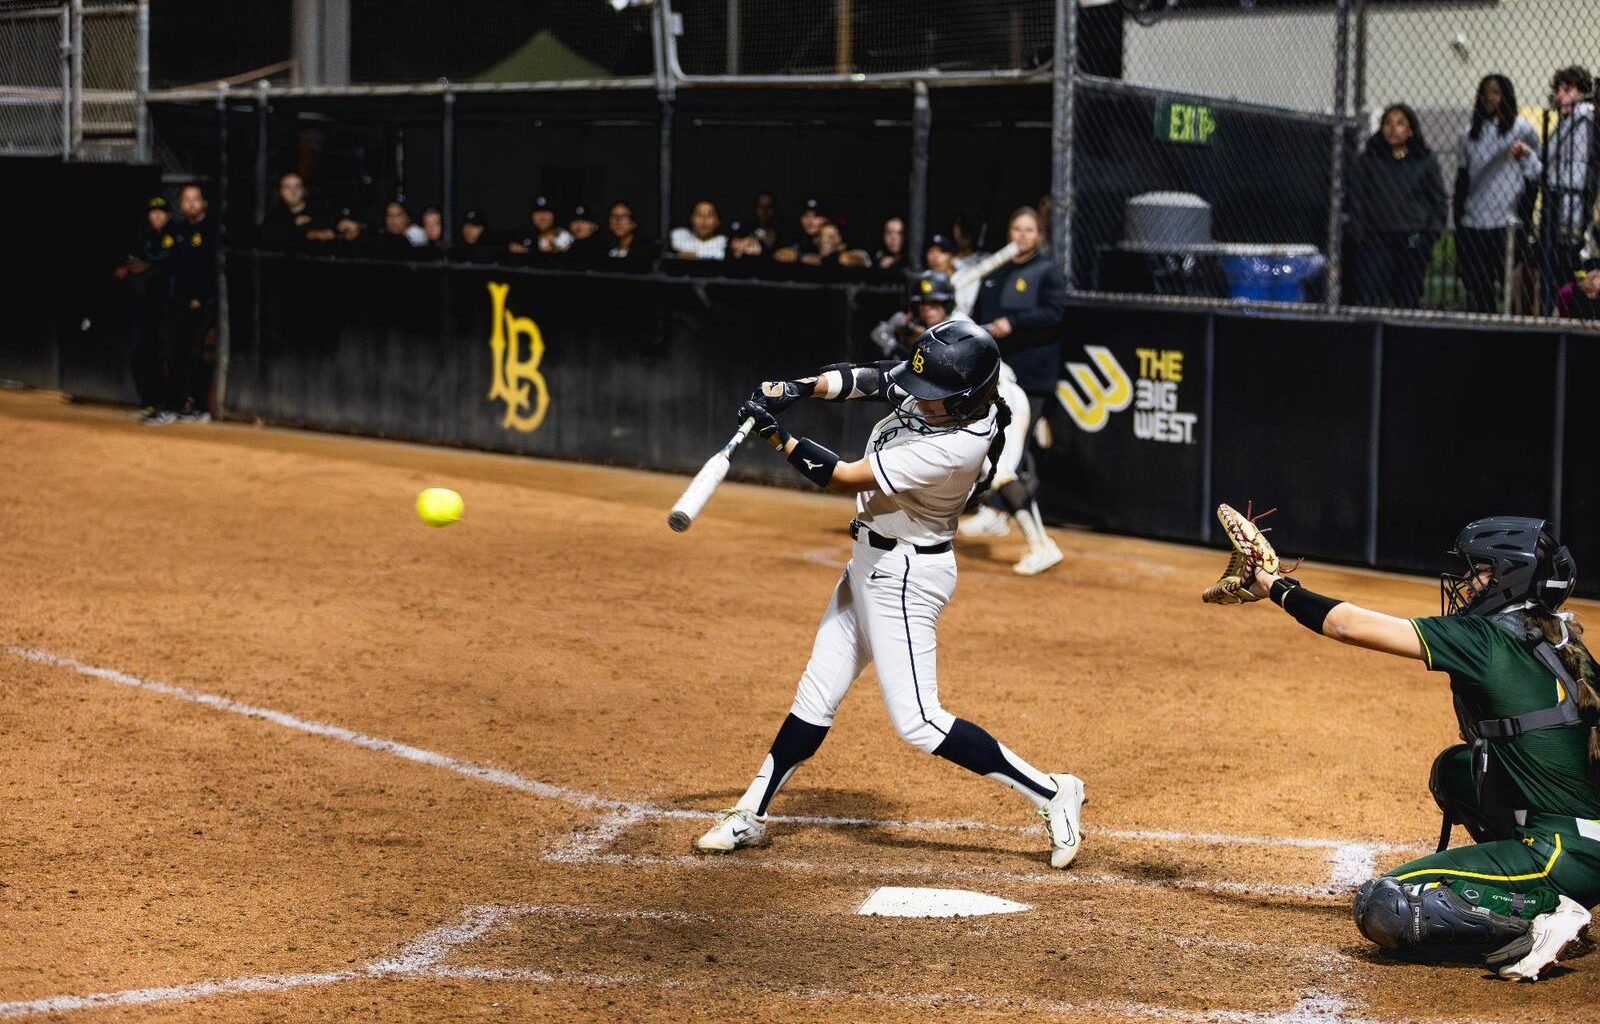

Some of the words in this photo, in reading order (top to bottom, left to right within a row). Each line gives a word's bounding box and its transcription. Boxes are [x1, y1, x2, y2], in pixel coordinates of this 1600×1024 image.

[1169, 103, 1209, 143] EXIT
[487, 281, 550, 432] LB
[912, 347, 925, 374] LB
[1135, 347, 1184, 382] THE
[1135, 378, 1178, 412] BIG
[1133, 410, 1197, 444] WEST
